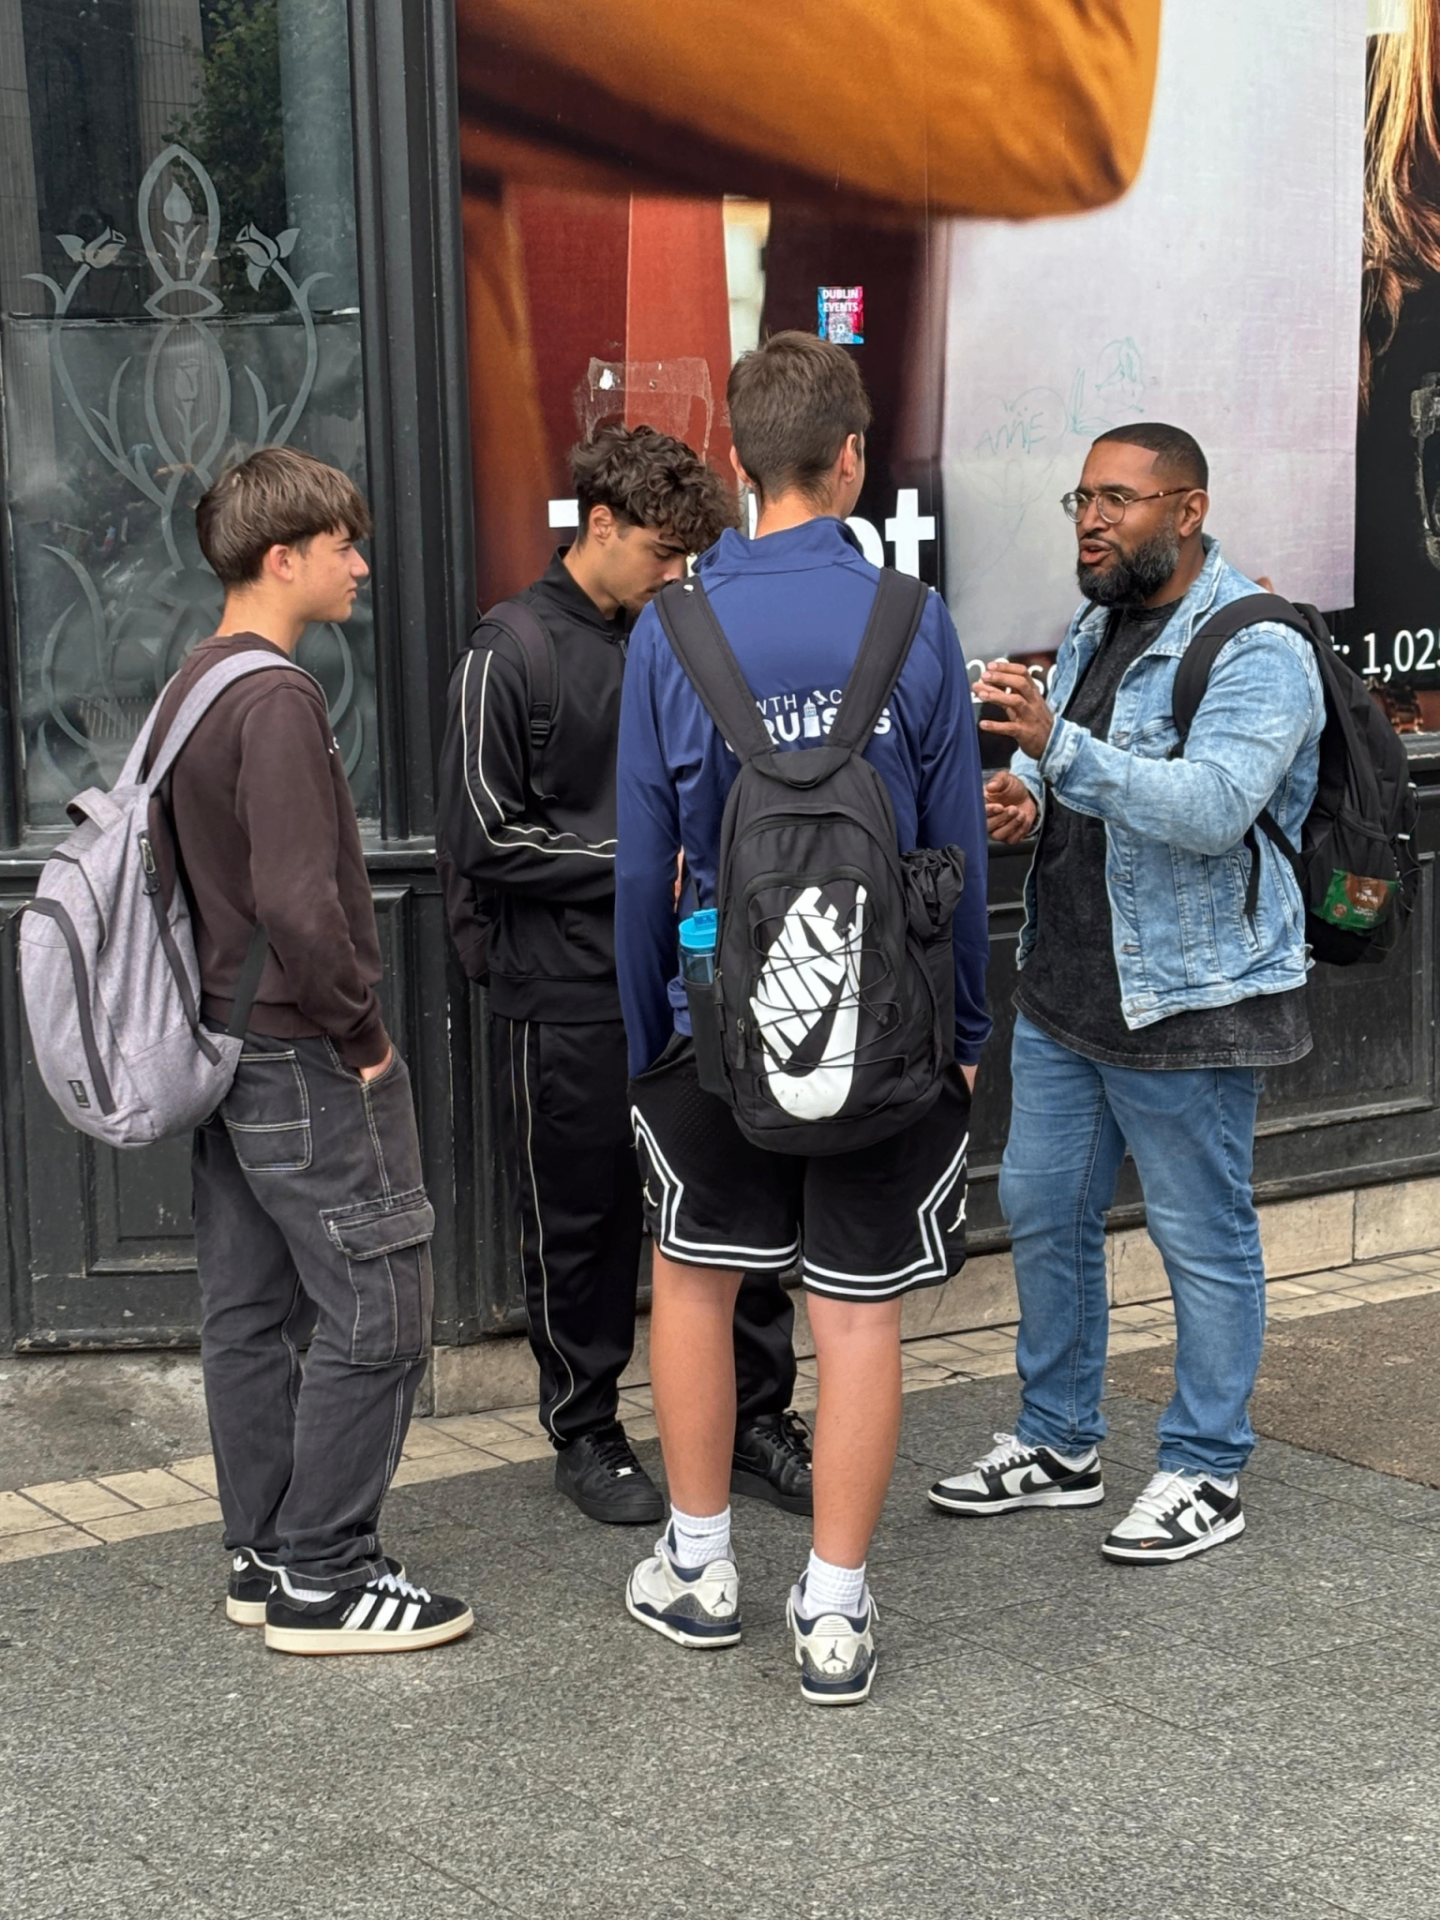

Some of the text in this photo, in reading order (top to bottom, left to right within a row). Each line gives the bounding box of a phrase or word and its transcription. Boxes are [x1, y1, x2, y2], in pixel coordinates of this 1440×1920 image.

[822, 289, 858, 299] DUBLIN
[823, 302, 858, 312] EVENTS
[1362, 627, 1440, 683] 1,02
